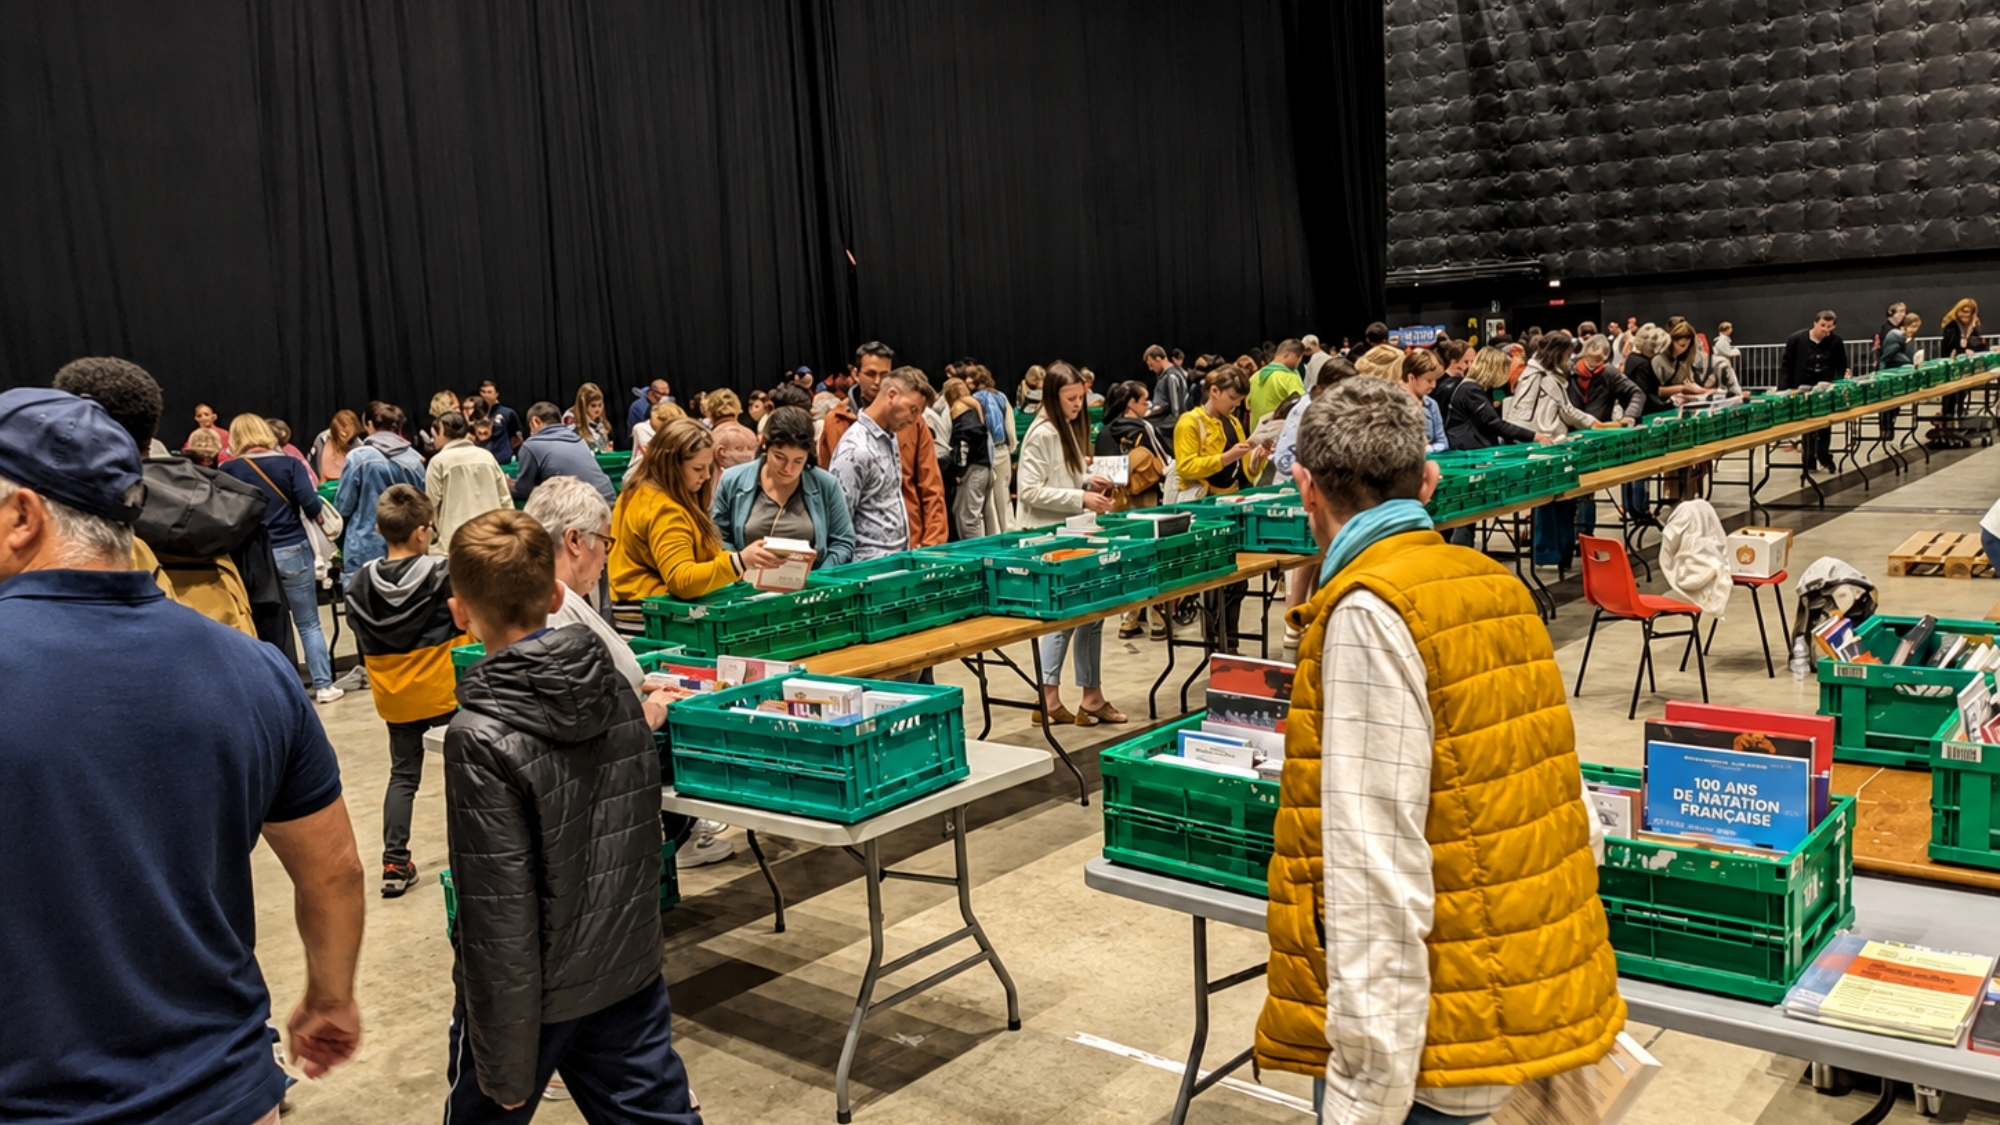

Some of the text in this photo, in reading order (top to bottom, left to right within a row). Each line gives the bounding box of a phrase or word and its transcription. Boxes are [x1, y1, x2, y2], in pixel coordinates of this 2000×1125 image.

[1694, 777, 1758, 797] 100 ANS
[1673, 788, 1694, 801] DE
[1698, 792, 1780, 814] NATATION
[1680, 803, 1771, 827] FRANÇAISE
